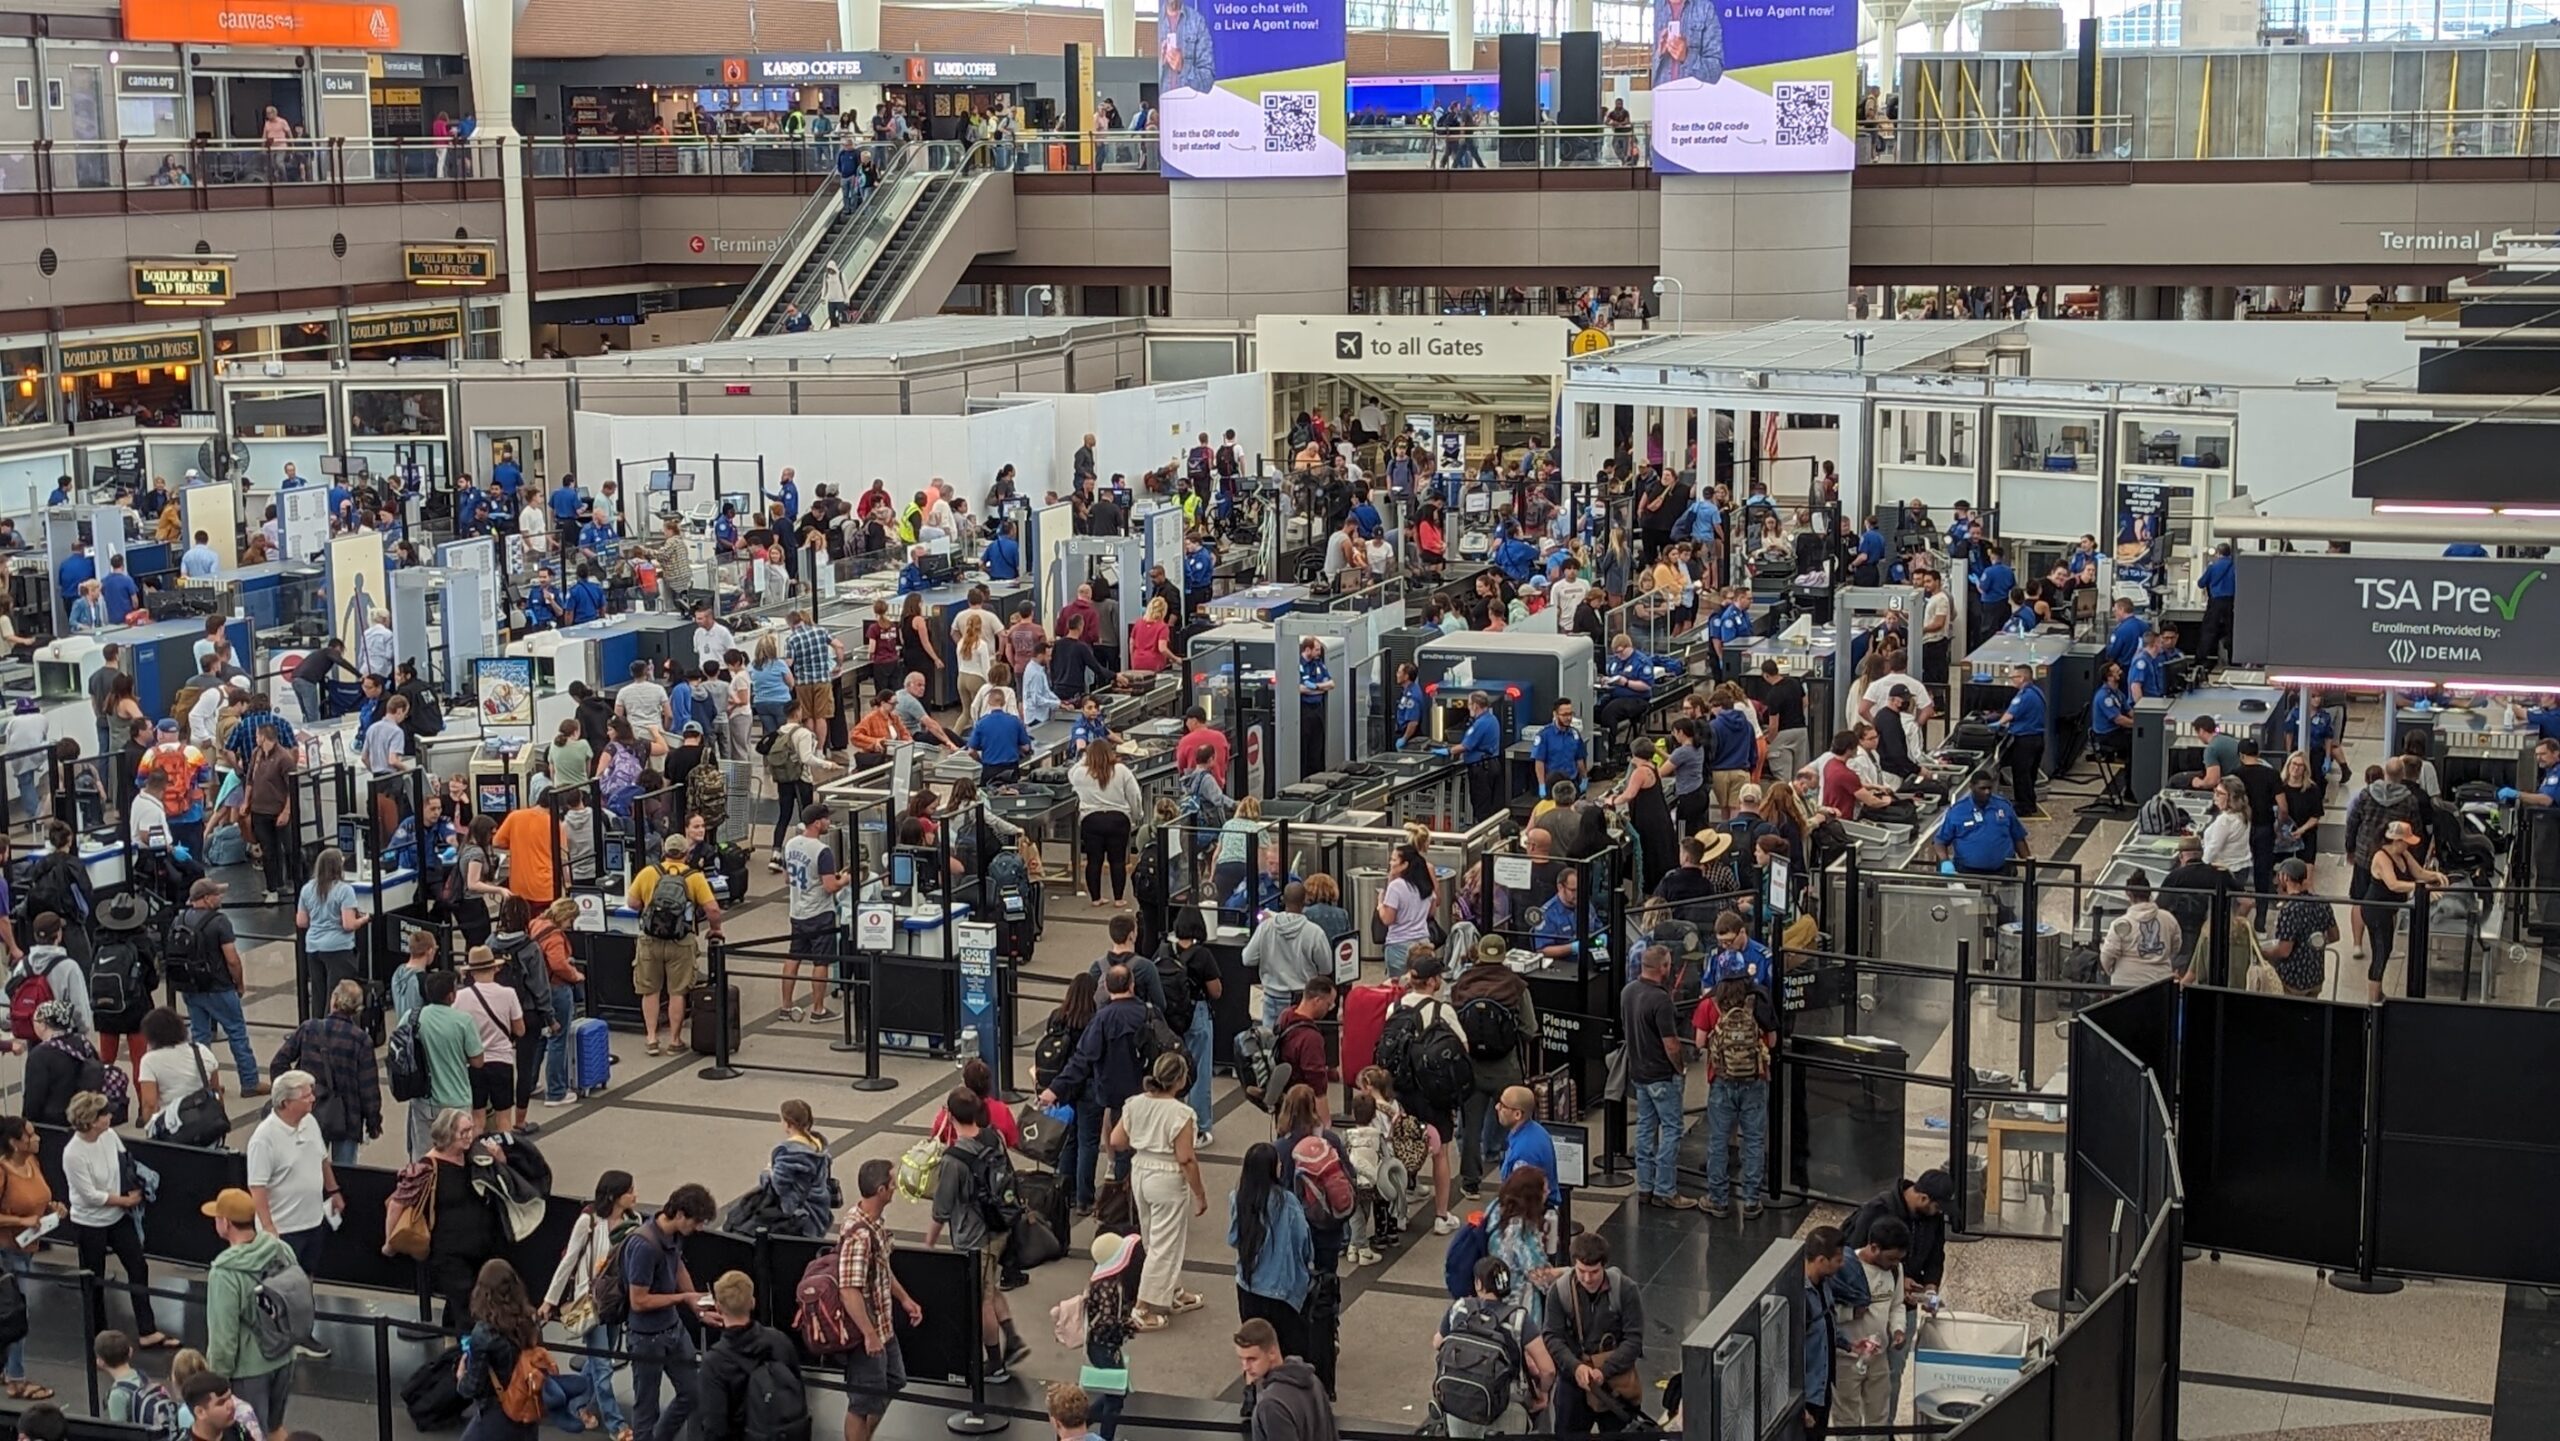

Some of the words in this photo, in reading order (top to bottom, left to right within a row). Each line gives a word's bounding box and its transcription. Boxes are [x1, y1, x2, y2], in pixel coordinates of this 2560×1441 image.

[1213, 3, 1247, 14] Video
[1250, 3, 1279, 14] chat
[1282, 3, 1308, 14] with
[1725, 10, 1732, 18] a
[1735, 6, 1763, 18] Live
[1766, 5, 1806, 19] Agent
[1808, 5, 1835, 17] now!
[218, 11, 275, 30] canvas
[1213, 22, 1222, 31] a
[1224, 20, 1250, 31] Live
[1252, 19, 1290, 32] Agent
[1292, 19, 1319, 30] now!
[810, 60, 862, 75] COFFEE
[964, 62, 997, 76] COFFEE
[127, 75, 175, 90] canvas.org
[325, 78, 336, 90] Go
[337, 78, 353, 90] Live
[1671, 123, 1690, 132] Scan
[1691, 122, 1705, 132] the
[1707, 122, 1722, 132] QR
[1723, 122, 1750, 131] code
[1202, 130, 1216, 139] QR
[1217, 130, 1240, 138] code
[1680, 136, 1693, 146] get
[1694, 136, 1728, 145] started
[1190, 142, 1221, 151] started
[710, 236, 783, 252] Terminal
[2380, 230, 2480, 250] Terminal
[414, 253, 456, 266] BOULDER
[457, 252, 480, 265] BEER
[142, 270, 190, 284] BOULDER
[192, 270, 219, 284] BEER
[422, 264, 443, 276] TAP
[444, 264, 473, 276] HOUSE
[152, 282, 174, 295] TAP
[175, 282, 211, 296] HOUSE
[350, 322, 388, 340] BOULDER
[389, 320, 410, 336] BEER
[412, 318, 429, 334] TAP
[430, 316, 455, 333] HOUSE
[62, 348, 110, 368] BOULDER
[112, 346, 138, 364] BEER
[140, 343, 160, 360] TAP
[161, 340, 196, 358] HOUSE
[1370, 339, 1392, 356] to
[1398, 338, 1421, 356] all
[1427, 338, 1484, 356] Gates
[1892, 596, 1900, 609] 3
[2354, 578, 2422, 611] TSA
[2432, 580, 2491, 614] Pre
[2372, 621, 2430, 636] Enrollment
[2432, 623, 2482, 638] Provided
[2483, 625, 2501, 639] by:
[2420, 646, 2482, 662] IDEMIA
[788, 862, 808, 890] 24
[960, 948, 991, 957] LOOSE
[960, 968, 991, 976] WORLD
[1542, 1013, 1580, 1030] Please
[1542, 1025, 1568, 1040] Wait
[1542, 1038, 1569, 1053] Here
[1934, 1373, 1976, 1384] FILTERED
[1976, 1376, 2010, 1386] WATER
